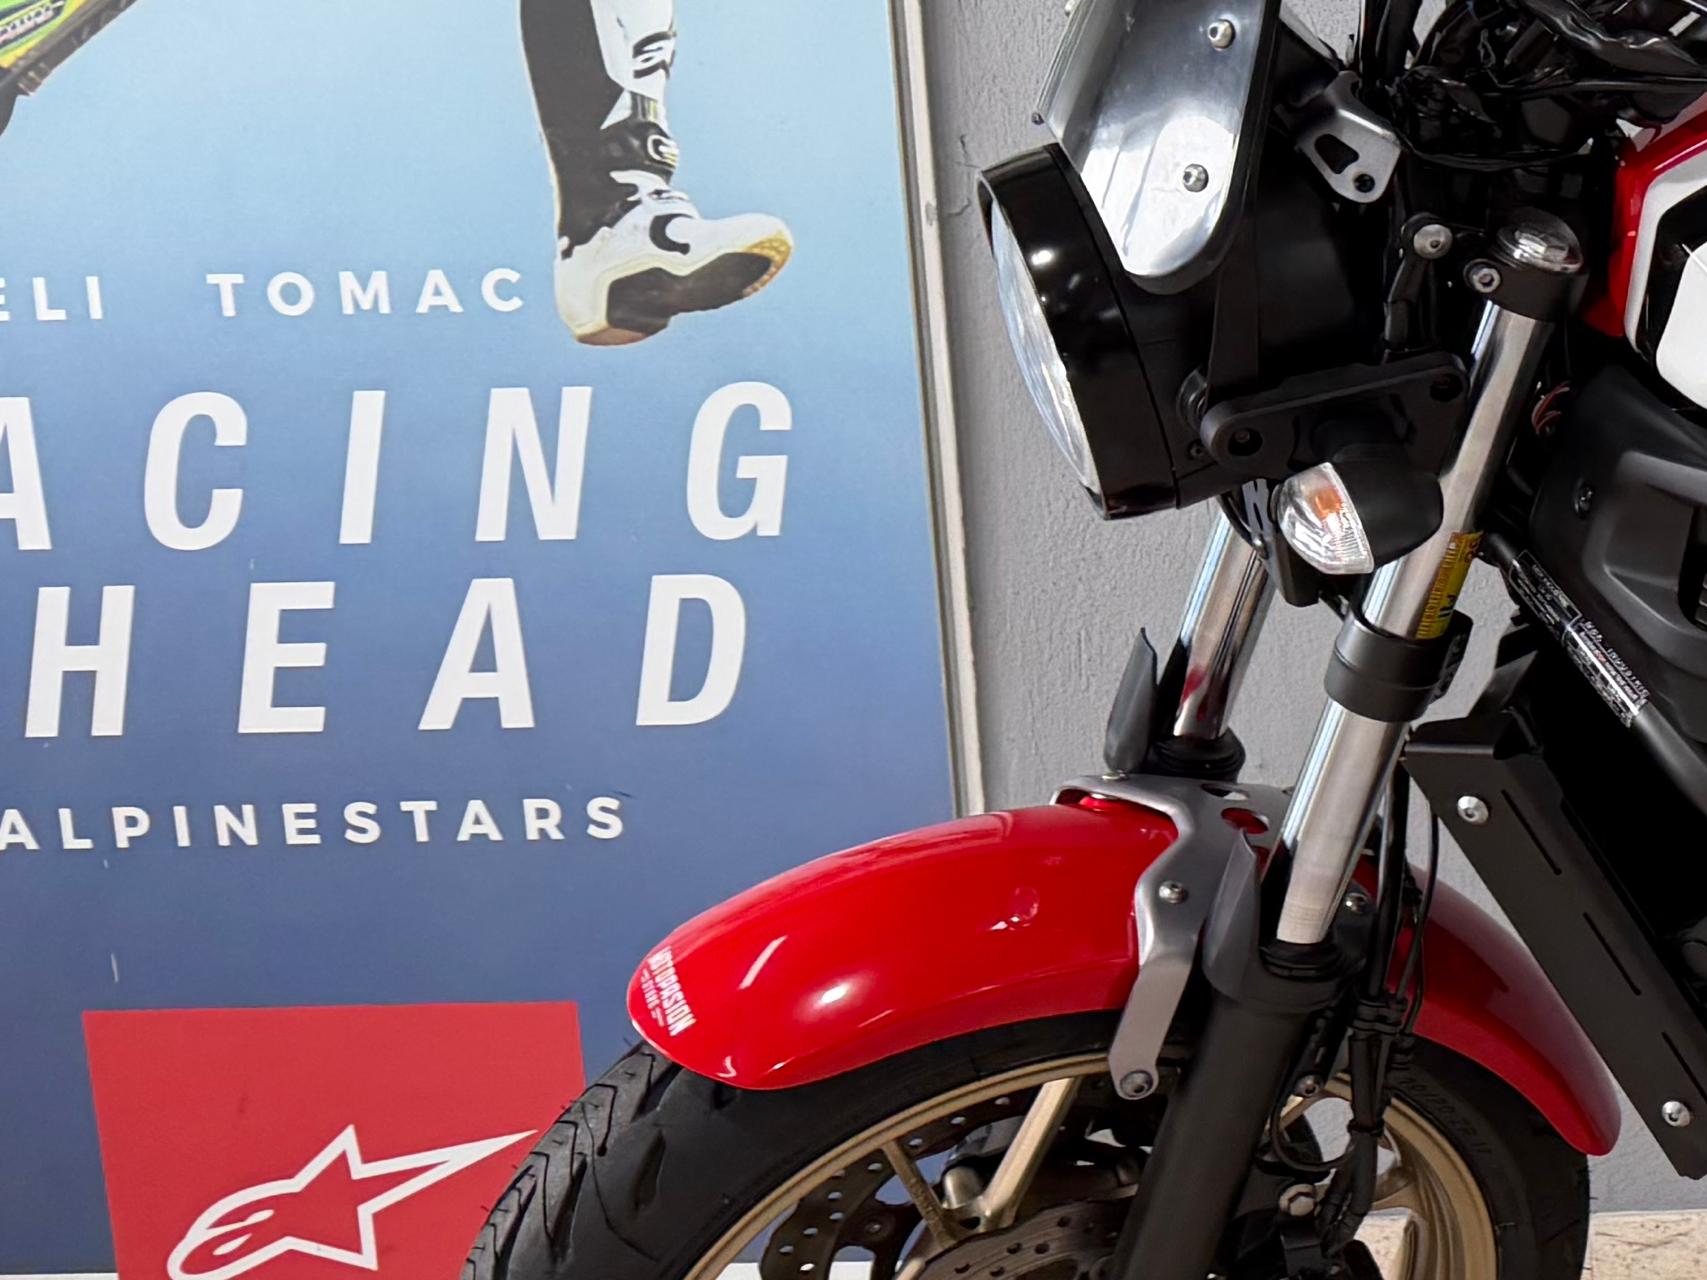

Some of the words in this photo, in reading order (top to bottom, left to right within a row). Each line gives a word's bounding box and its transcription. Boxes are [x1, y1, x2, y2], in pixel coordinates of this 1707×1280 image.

[206, 268, 524, 318] TOMAC
[24, 573, 749, 738] HEAD
[0, 795, 627, 850] ALPINESTARS
